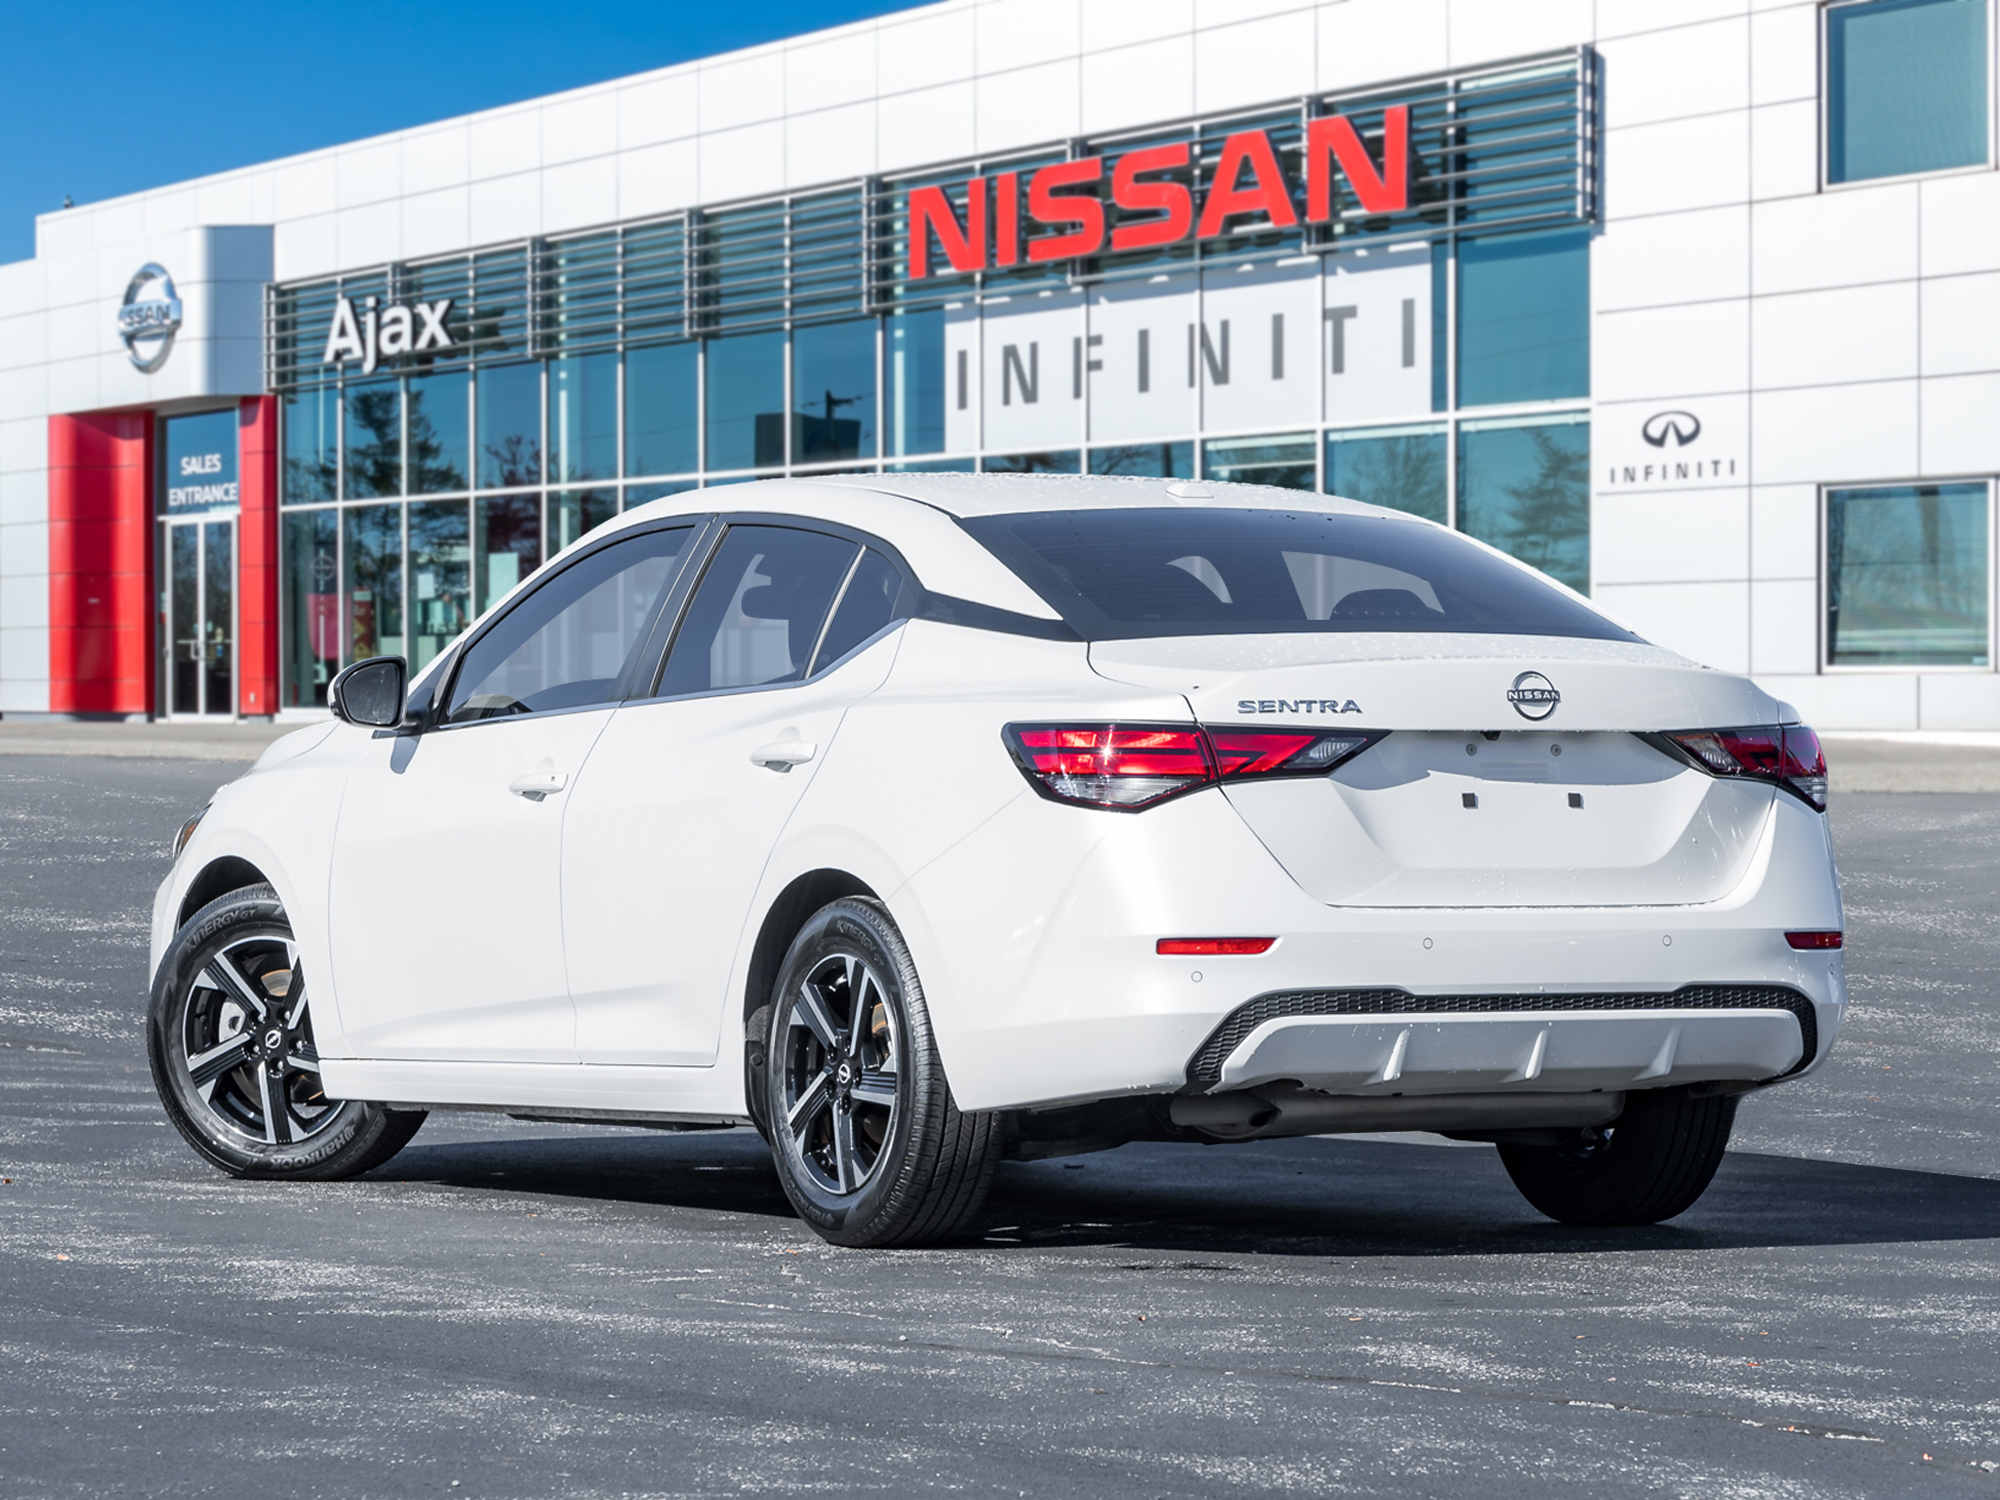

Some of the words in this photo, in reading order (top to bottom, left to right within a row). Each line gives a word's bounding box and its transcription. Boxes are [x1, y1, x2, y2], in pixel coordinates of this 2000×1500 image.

[908, 104, 1410, 280] NISSAN
[120, 303, 172, 327] SSAN
[324, 296, 455, 373] Ajax
[957, 298, 1415, 411] INFINITI
[180, 453, 222, 476] SALES
[1609, 459, 1736, 485] INFINITI
[168, 482, 238, 507] ENTRANCE
[1237, 700, 1363, 714] SENTRA
[1508, 690, 1560, 700] NISSAN
